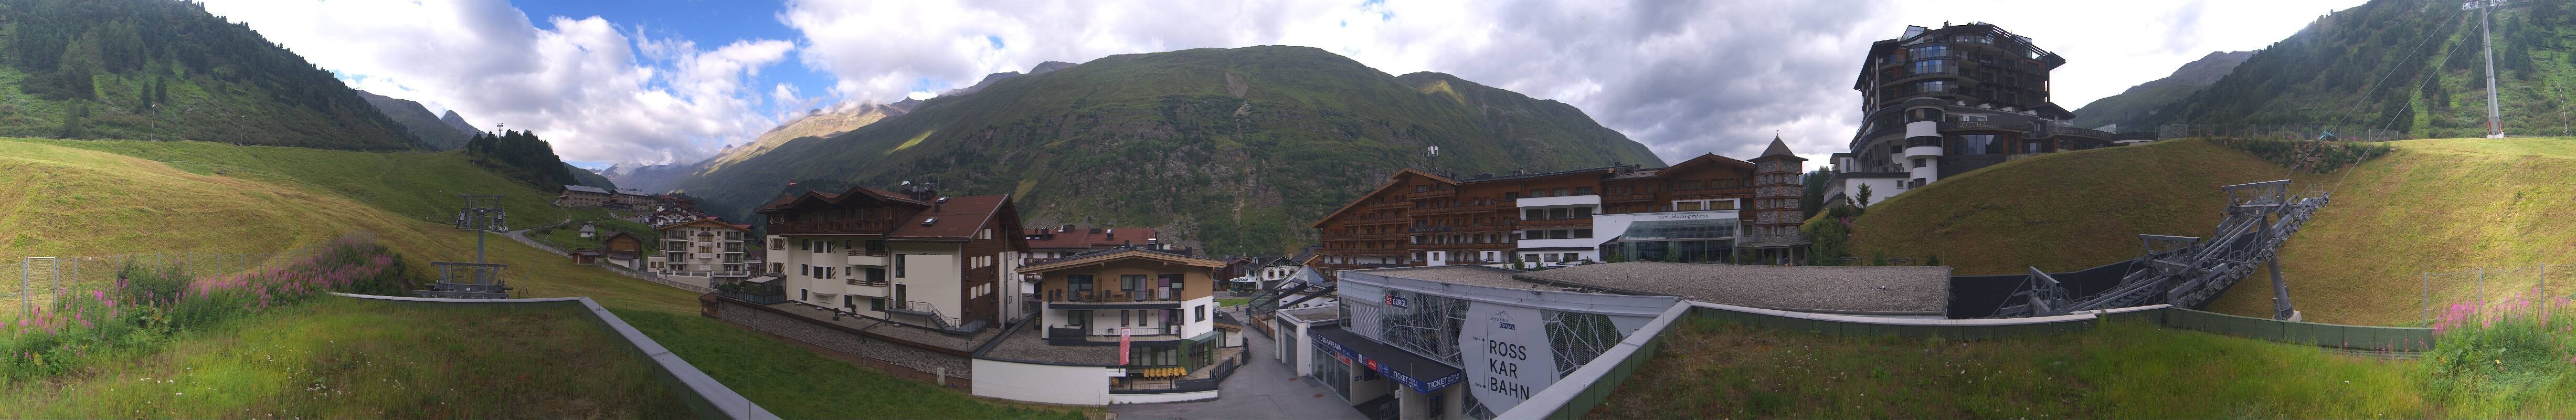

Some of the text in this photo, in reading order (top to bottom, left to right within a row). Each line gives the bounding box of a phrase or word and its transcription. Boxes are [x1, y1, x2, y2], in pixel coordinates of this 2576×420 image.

[1393, 298, 1407, 307] GURGL
[1318, 334, 1342, 352] ROSSKARBAHN
[1490, 340, 1526, 361] ROSS
[1393, 371, 1408, 383] TICKET
[1490, 358, 1518, 379] KAR
[1427, 376, 1448, 389] TICKET
[1490, 376, 1530, 400] BAHN
